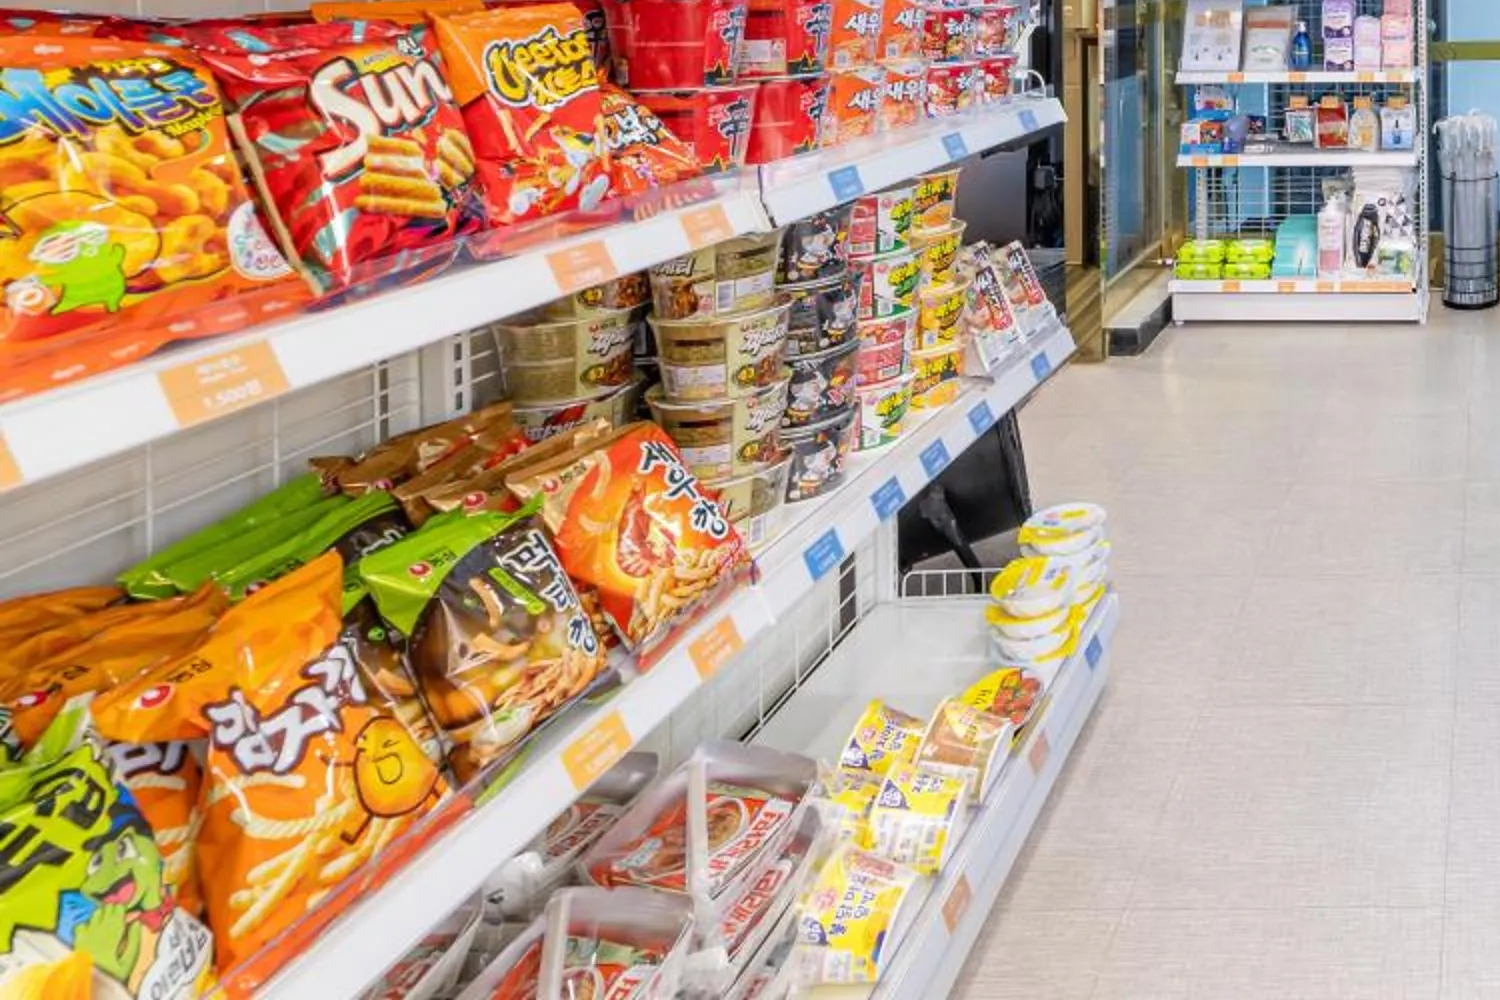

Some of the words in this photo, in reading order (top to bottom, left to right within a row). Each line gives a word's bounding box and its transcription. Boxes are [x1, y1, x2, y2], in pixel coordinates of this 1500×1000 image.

[309, 57, 453, 176] Sun
[639, 440, 729, 537] 새우깡
[498, 529, 597, 657] 먹태깡
